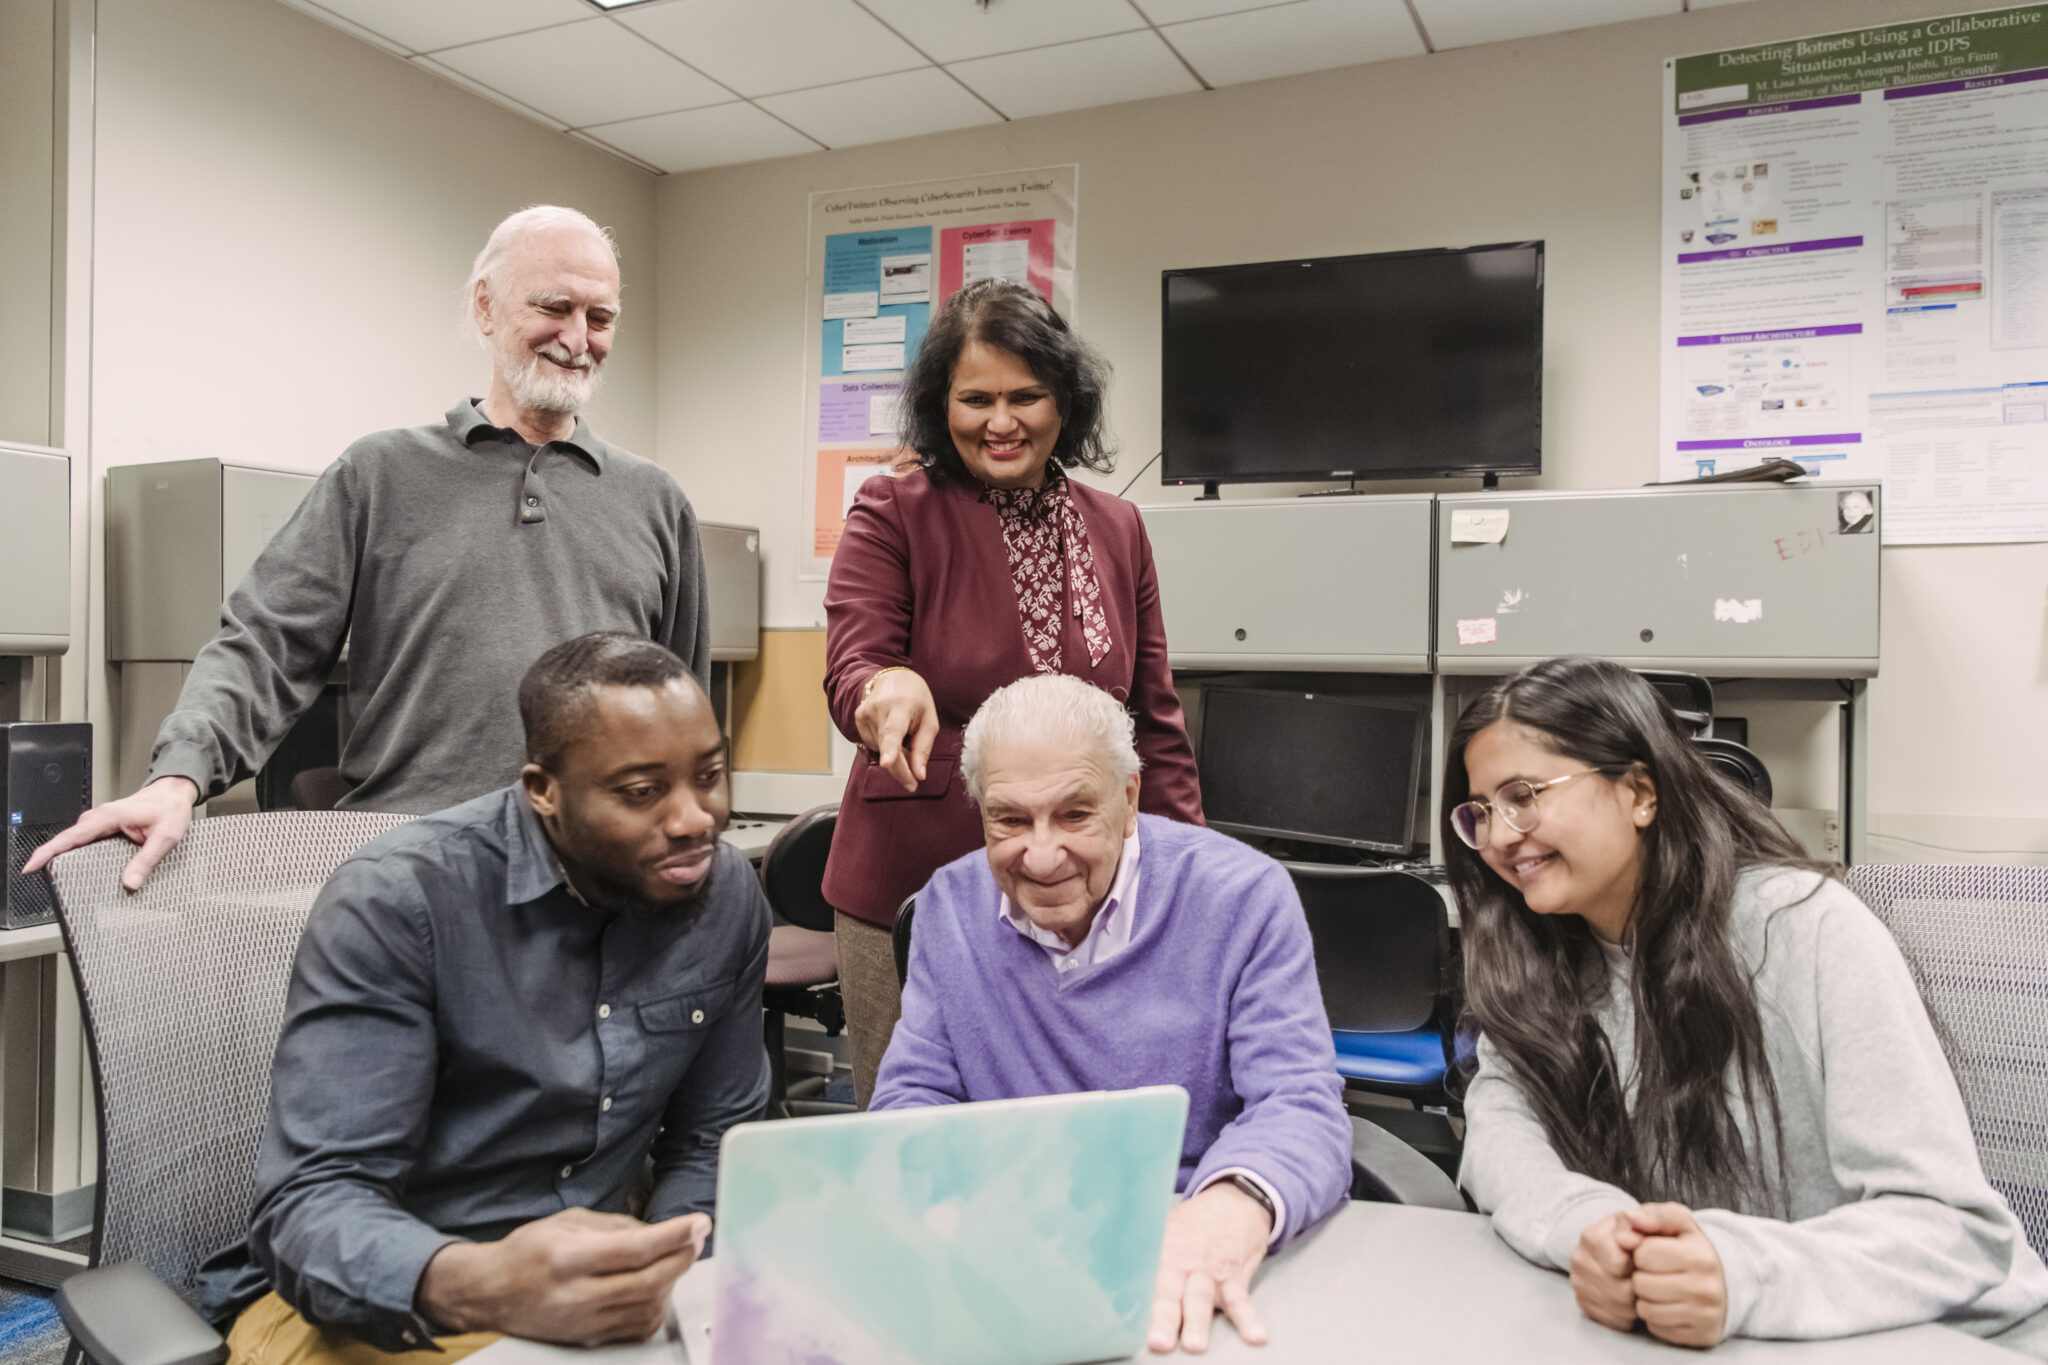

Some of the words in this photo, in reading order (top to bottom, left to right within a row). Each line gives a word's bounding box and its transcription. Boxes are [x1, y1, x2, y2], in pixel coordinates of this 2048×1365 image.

[1719, 47, 1792, 67] Detecting
[1796, 36, 1855, 56] Botnets
[1860, 29, 1909, 46] Using
[1912, 28, 1922, 39] a
[1926, 11, 2041, 36] Collaborative
[1781, 45, 1923, 76] Situational-aware
[1928, 36, 1970, 55] IDPS
[1855, 65, 1904, 79] Anupam
[1943, 55, 1964, 67] Tim
[1968, 50, 1999, 63] Finin
[1758, 88, 1813, 102] University
[1817, 86, 1829, 95] of
[1893, 69, 1949, 86] Baltimore
[1951, 64, 1995, 77] County
[879, 197, 919, 207] Observing
[921, 190, 975, 203] CyberSecurity
[977, 187, 1004, 196] Events
[858, 236, 898, 246] Motivation
[1003, 226, 1032, 236] Events
[842, 384, 859, 392] Data
[861, 383, 900, 391] Collection
